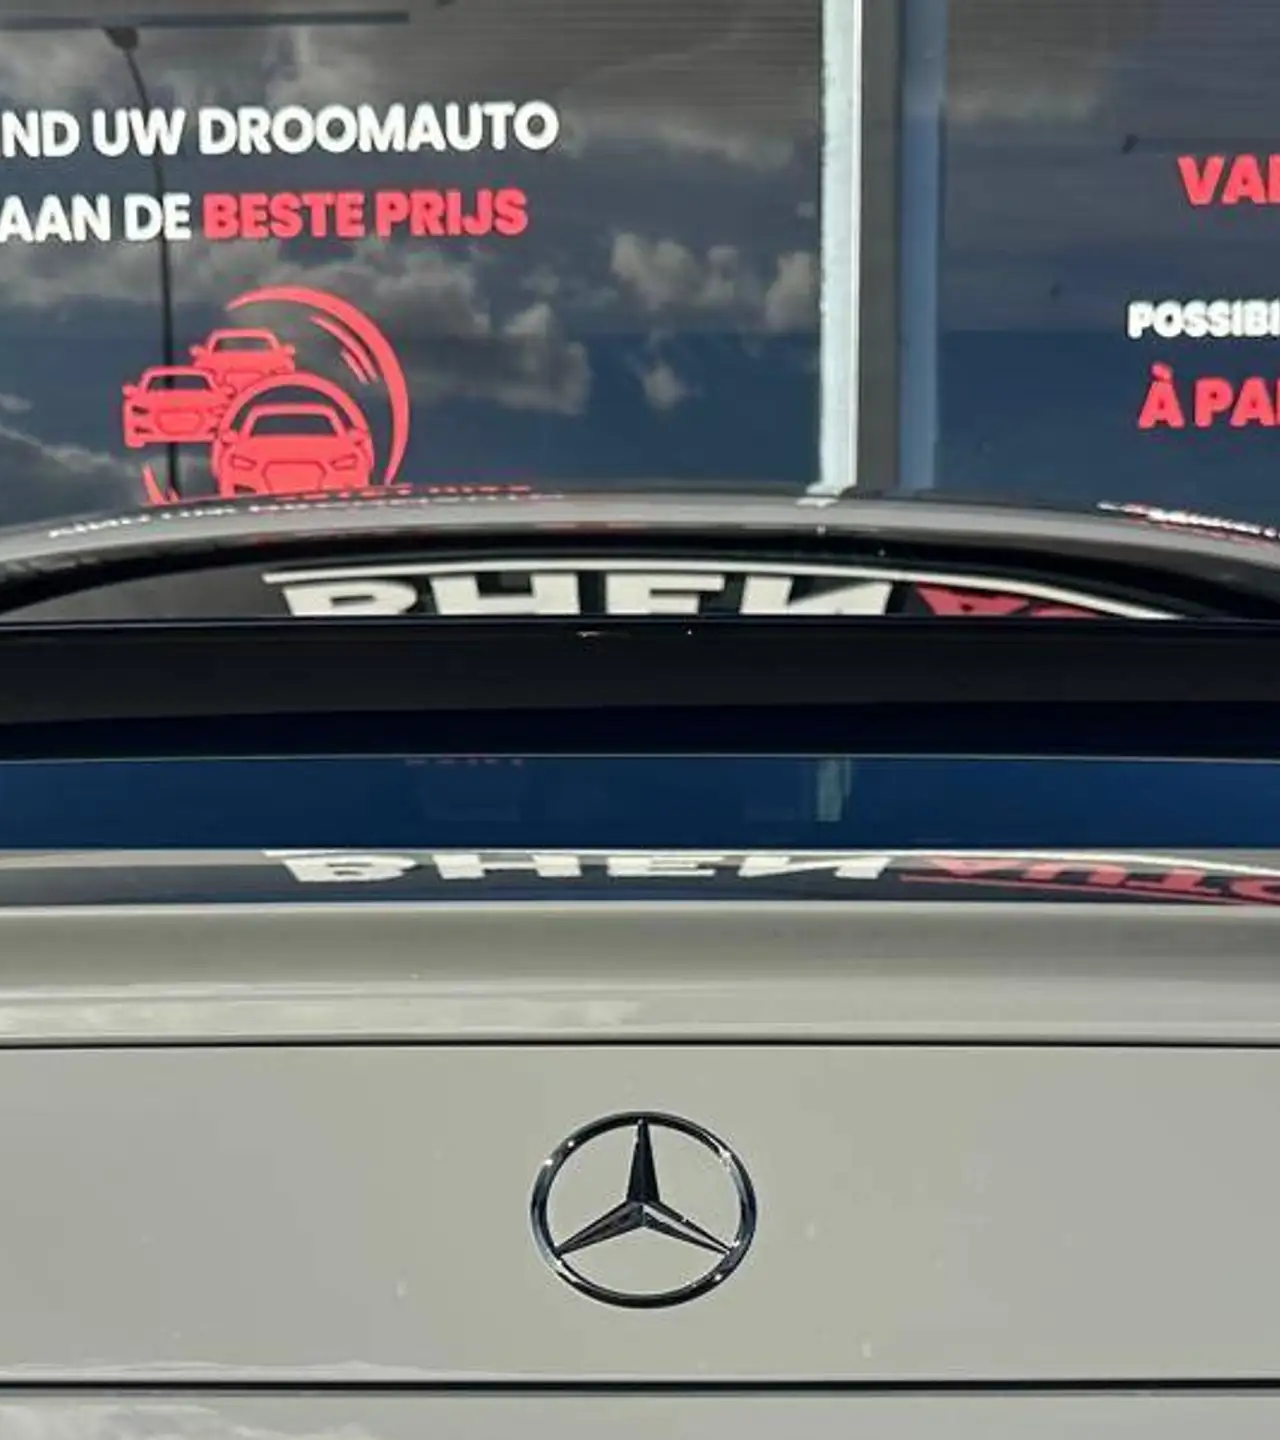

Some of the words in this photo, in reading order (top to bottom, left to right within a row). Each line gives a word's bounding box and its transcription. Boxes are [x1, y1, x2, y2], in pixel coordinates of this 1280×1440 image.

[92, 108, 186, 155] UW
[198, 100, 560, 153] DROOMAUTO
[124, 194, 192, 241] DE
[203, 191, 365, 238] BESTE
[376, 187, 528, 237] PRIJS
[1138, 361, 1184, 428] À
